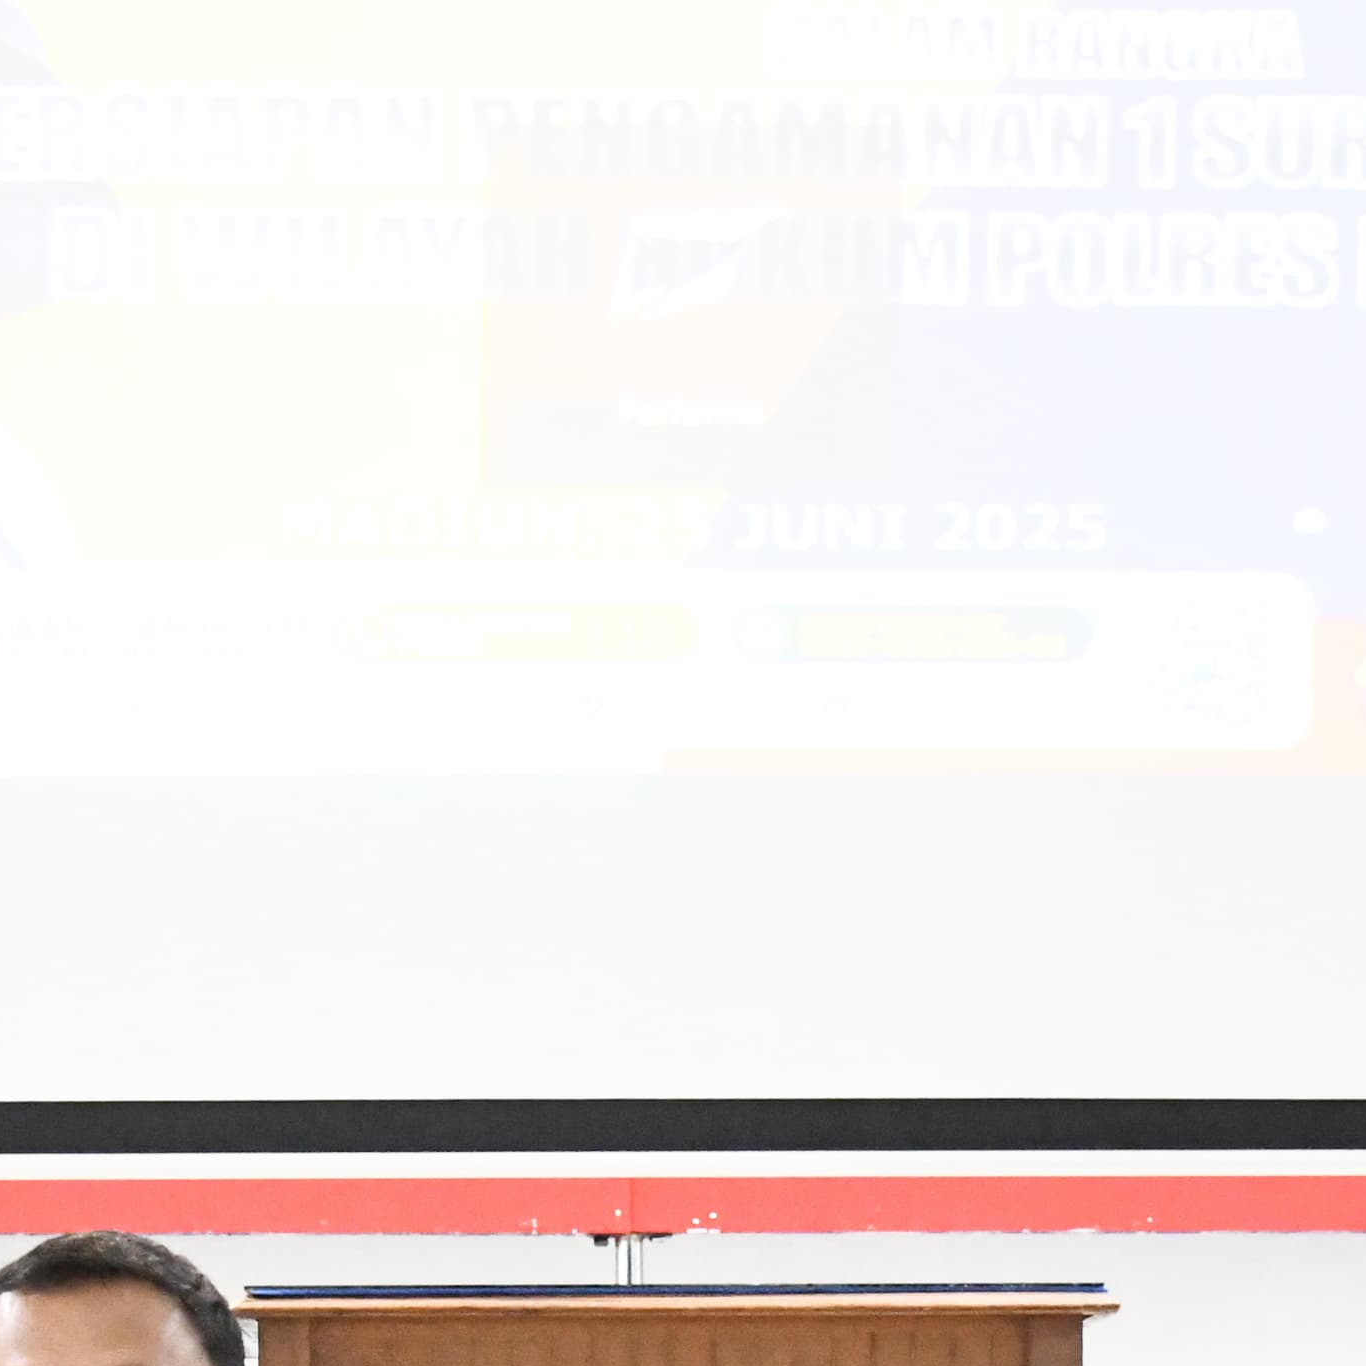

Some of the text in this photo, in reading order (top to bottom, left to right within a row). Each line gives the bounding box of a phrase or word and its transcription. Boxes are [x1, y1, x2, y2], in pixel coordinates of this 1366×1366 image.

[459, 88, 1107, 187] PENGAMANAN
[988, 210, 1338, 308] POLRES
[933, 502, 1107, 552] 2025
